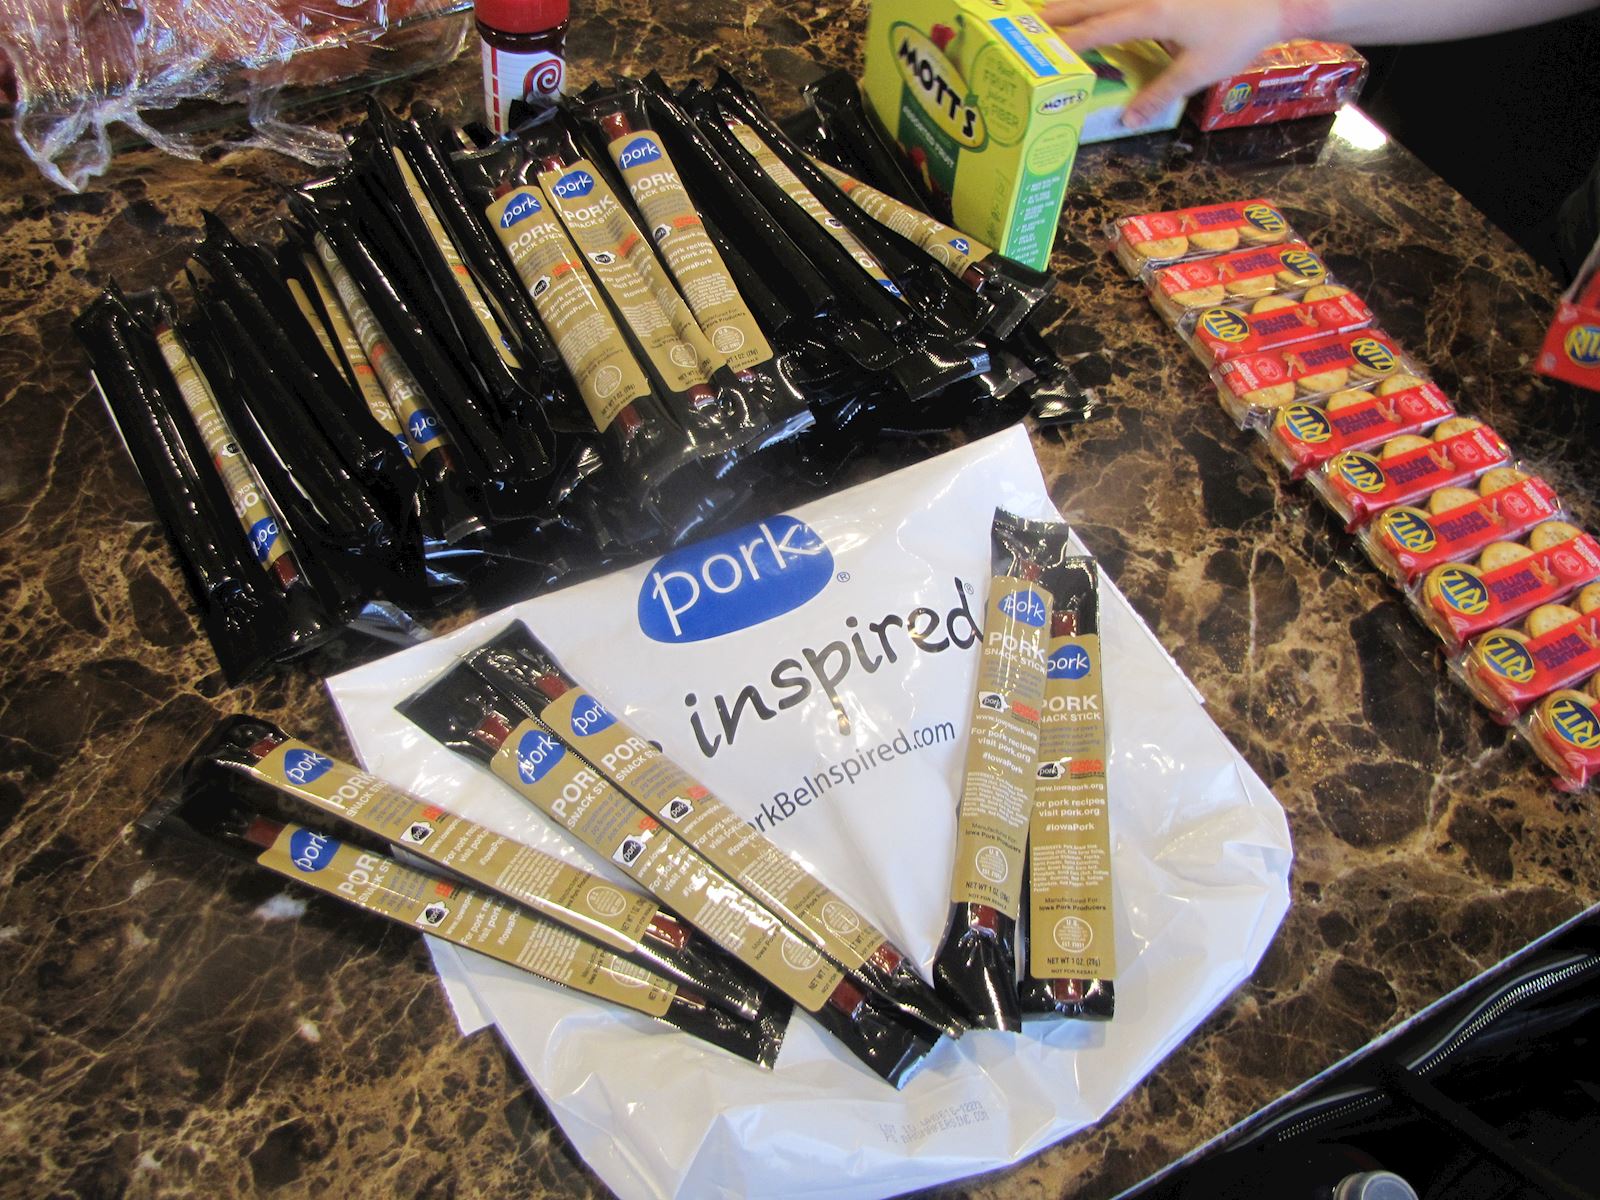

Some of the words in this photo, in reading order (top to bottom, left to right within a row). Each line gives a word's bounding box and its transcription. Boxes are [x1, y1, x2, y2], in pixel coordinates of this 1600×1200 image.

[897, 38, 976, 138] MOTT'S
[620, 142, 661, 169] pork
[555, 174, 592, 198] pork
[636, 188, 658, 204] NACK
[502, 197, 540, 227] pork
[564, 195, 614, 221] PORK
[598, 203, 620, 224] STICK
[1244, 204, 1287, 233] RITZ
[508, 221, 560, 257] PORK
[538, 232, 565, 244] STICK
[1281, 249, 1325, 278] RITZ
[1202, 311, 1249, 342] RITZ
[1351, 338, 1395, 372] RITZ
[1285, 405, 1332, 443] RITZ
[1338, 456, 1385, 493] RITZ
[1384, 511, 1437, 552] RITZ
[652, 523, 824, 636] pork
[1438, 570, 1490, 614] RITZ
[988, 631, 1046, 664] PORK
[1482, 637, 1537, 682] RITZ
[685, 577, 983, 758] inspired
[1040, 713, 1068, 723] NACK
[1070, 711, 1101, 722] STICK
[1549, 700, 1600, 748] RITZ
[971, 727, 986, 735] For
[988, 728, 1007, 741] pork
[1008, 736, 1037, 755] recipes
[977, 738, 997, 747] visit
[998, 742, 1031, 763] pork.org
[286, 752, 327, 784] pork
[520, 735, 560, 781] pork
[615, 753, 647, 782] SNACK
[982, 751, 1024, 775] #IowaPork
[567, 793, 596, 829] SNACK
[1035, 800, 1046, 808] or
[1047, 797, 1070, 809] pork
[1071, 797, 1106, 808] recipes
[1039, 807, 1059, 817] visit
[1060, 807, 1100, 818] pork.org
[1045, 821, 1095, 832] #IowaPork
[294, 831, 331, 871] pork
[623, 841, 638, 861] pork
[693, 833, 708, 850] For
[337, 853, 380, 896] POR
[1047, 957, 1059, 965] NET
